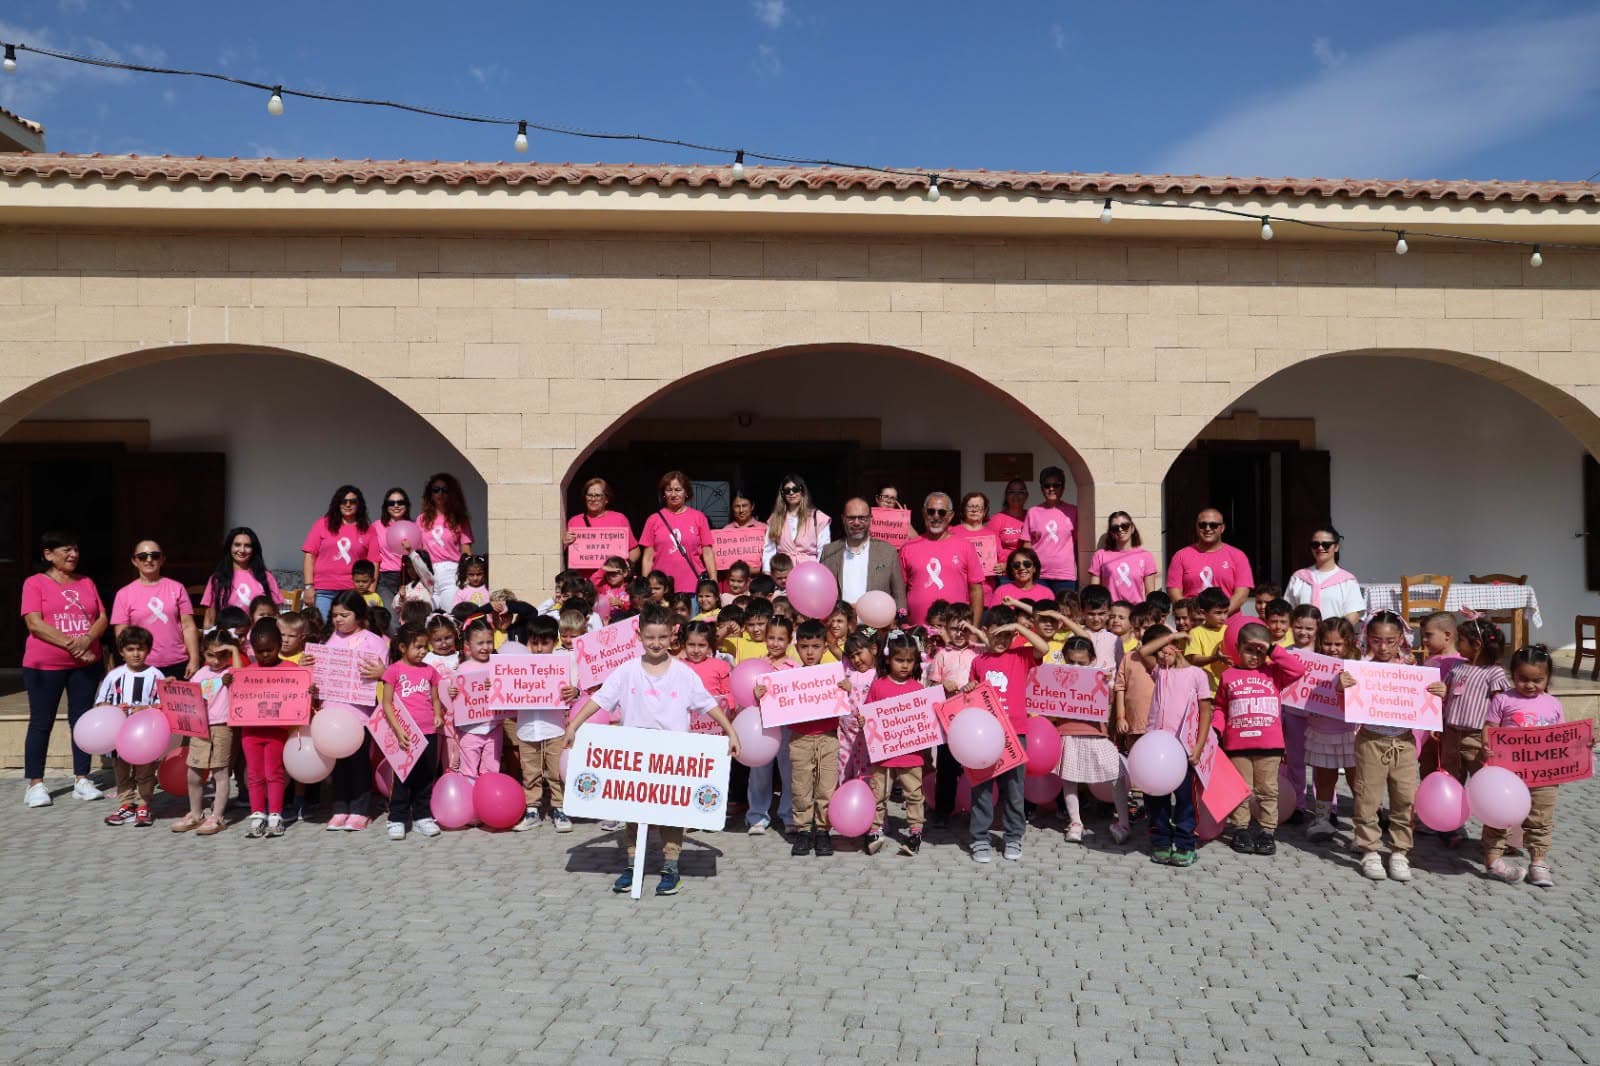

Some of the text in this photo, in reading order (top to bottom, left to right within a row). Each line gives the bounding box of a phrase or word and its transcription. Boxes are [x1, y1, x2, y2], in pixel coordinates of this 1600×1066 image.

[585, 652, 597, 665] Bir
[495, 663, 566, 679] Erken Teşhis
[591, 663, 604, 675] Bir
[513, 679, 546, 693] Hayat
[772, 683, 788, 696] Bir
[1032, 685, 1067, 699] Erken
[506, 692, 554, 705] Kurtarır!
[778, 695, 796, 708] Bir
[1371, 694, 1415, 707] Kendini
[875, 697, 928, 718] Pembe Bir
[1058, 701, 1106, 717] Yarınlar
[881, 711, 929, 729] Dokunuş,
[883, 721, 931, 742] Büyük Bir
[1496, 727, 1582, 746] Korku değil,
[882, 731, 939, 754] Farkındalık
[585, 742, 716, 779] İSKELE MAARİF
[1511, 746, 1570, 762] BİLMEK
[1531, 761, 1580, 783] yaşatır!
[601, 778, 692, 807] ANAOKULU
